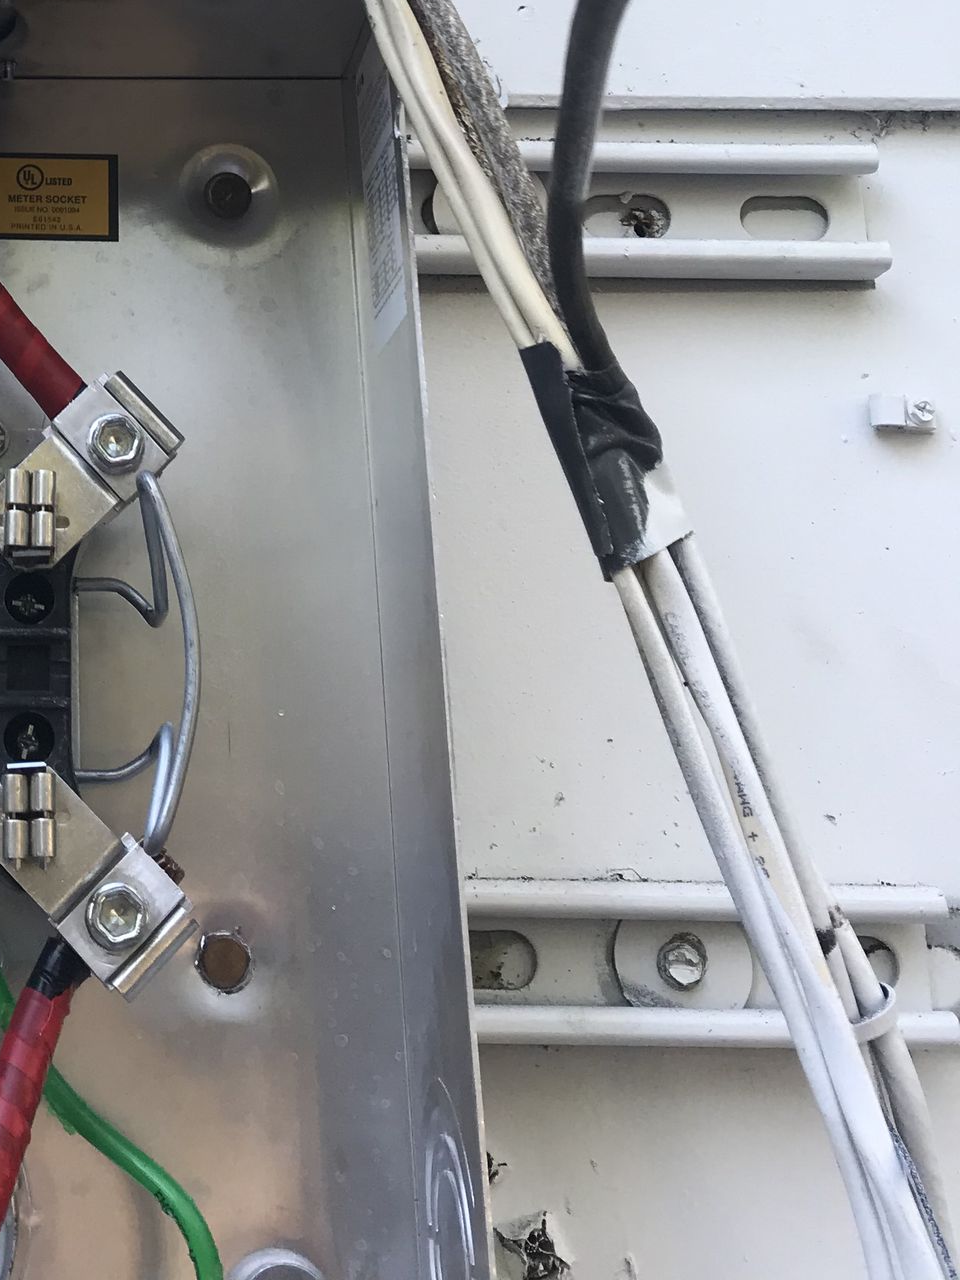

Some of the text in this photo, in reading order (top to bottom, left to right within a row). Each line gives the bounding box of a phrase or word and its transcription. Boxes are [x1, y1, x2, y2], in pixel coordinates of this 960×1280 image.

[45, 177, 73, 186] LISTED
[8, 194, 88, 205] METER SOCKET
